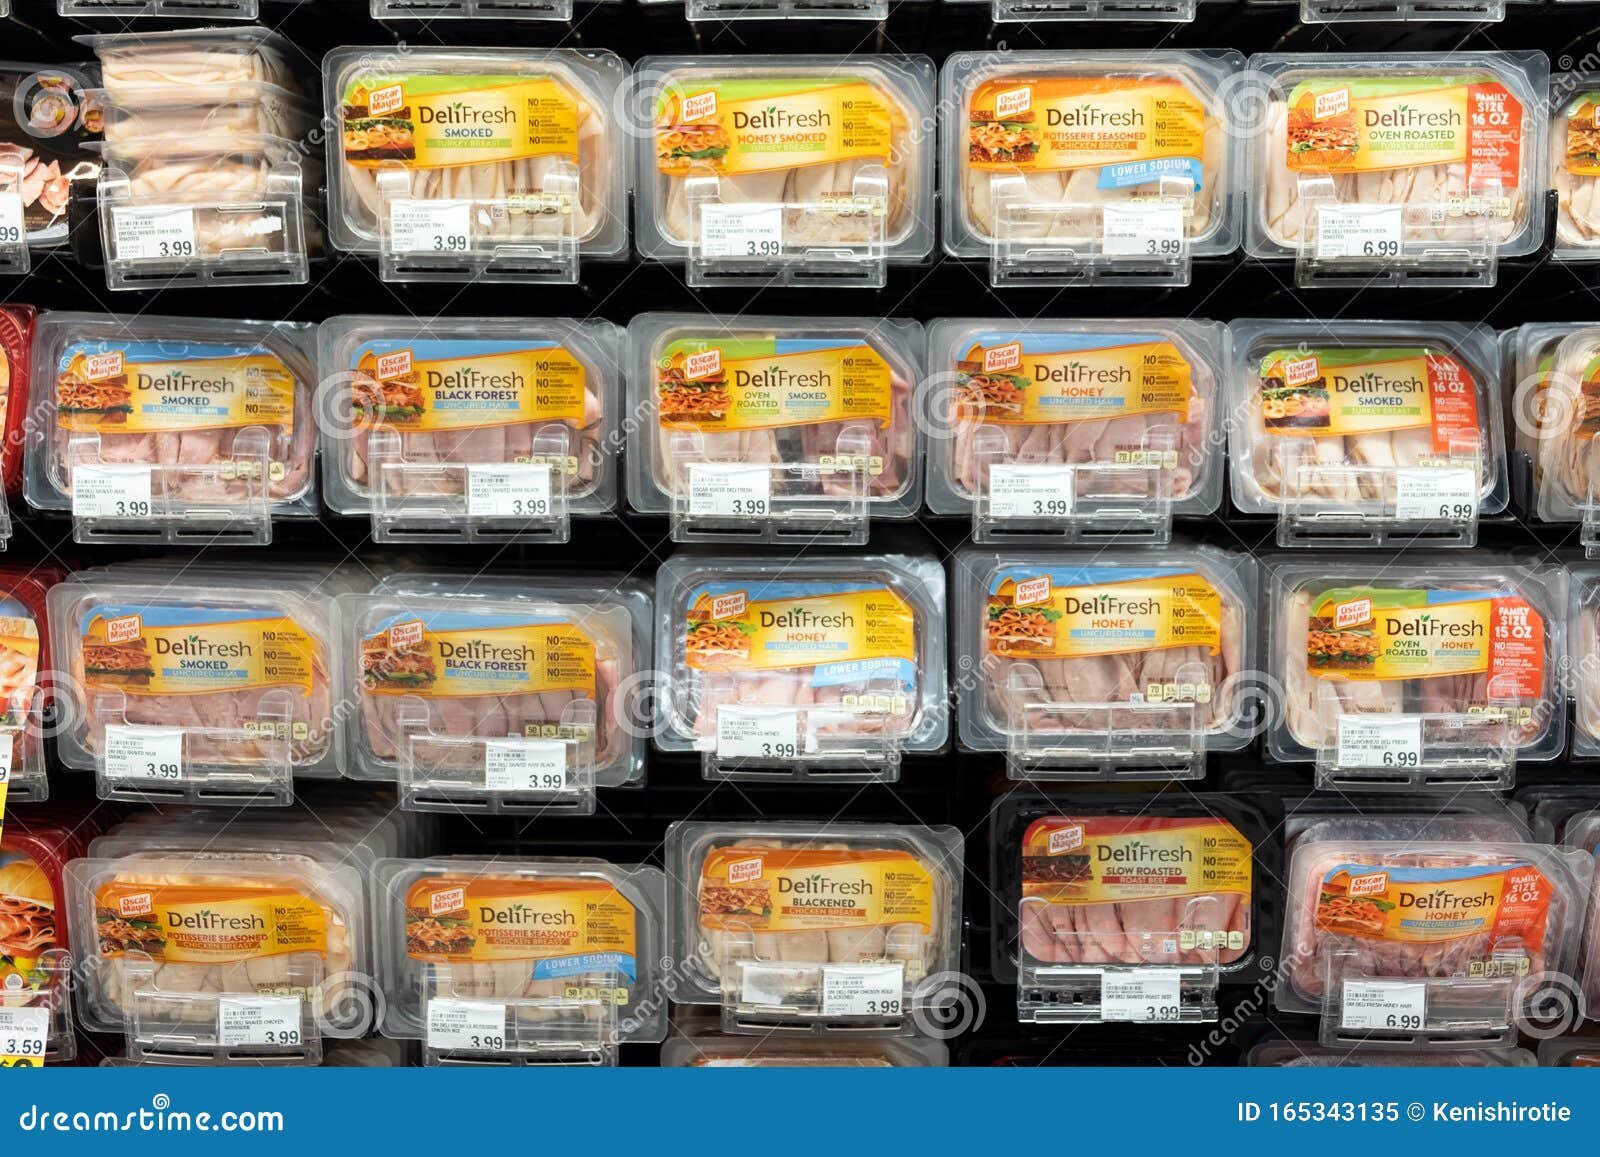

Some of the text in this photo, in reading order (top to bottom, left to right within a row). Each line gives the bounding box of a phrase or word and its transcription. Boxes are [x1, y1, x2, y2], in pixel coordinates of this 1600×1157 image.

[373, 90, 398, 102] Oscar
[687, 95, 712, 108] Oscar
[1001, 91, 1026, 104] Oscar
[1475, 93, 1507, 101] FAMILY
[372, 98, 401, 111] Mayer
[685, 102, 715, 117] Mayer
[999, 98, 1028, 113] Mayer
[1478, 103, 1503, 112] SIZE
[418, 105, 516, 124] DeliFresh
[733, 109, 830, 128] DeliFresh
[1046, 108, 1144, 126] DeliFresh
[1365, 109, 1460, 127] DeliFresh
[1472, 113, 1509, 125] 16 OZ
[445, 128, 493, 137] SMOKED
[738, 133, 826, 144] HONEY SMOKED
[1369, 130, 1454, 140] OVEN ROASTED
[1112, 160, 1191, 177] LOWER SODIUM
[160, 241, 192, 256] 3.99
[434, 235, 466, 250] 3.99
[747, 240, 779, 255] 3.99
[1146, 240, 1180, 253] 3.99
[1364, 241, 1398, 255] 6.99
[690, 354, 716, 365] Oscar
[989, 348, 1015, 360] Oscar
[91, 357, 118, 367] Oscar
[381, 355, 408, 366] Oscar
[988, 356, 1017, 367] Mayer
[90, 364, 120, 376] Mayer
[380, 362, 411, 376] Mayer
[689, 362, 718, 375] Mayer
[1034, 364, 1131, 383] DeliFresh
[138, 374, 234, 393] DeliFresh
[427, 370, 524, 388] DeliFresh
[735, 369, 830, 387] DeliFresh
[1333, 375, 1424, 393] DeliFresh
[1061, 388, 1104, 396] HONEY
[1433, 382, 1465, 392] 16 OZ
[162, 396, 210, 405] SMOKED
[435, 391, 518, 399] BLACK FOREST
[1358, 397, 1403, 406] SMOKED
[116, 501, 148, 515] 3.99
[513, 500, 546, 514] 3.99
[732, 500, 765, 514] 3.99
[1033, 500, 1066, 514] 3.99
[1440, 505, 1472, 519] 6.99
[1020, 581, 1045, 593] Oscar
[1019, 588, 1049, 601] Mayer
[716, 596, 742, 608] Oscar
[1065, 597, 1160, 614] DeliFresh
[715, 603, 744, 615] Mayer
[1340, 602, 1367, 616] Oscar
[1499, 607, 1529, 616] FAMILY
[760, 611, 853, 628] DeliFresh
[1339, 610, 1369, 625] Mayer
[1501, 616, 1527, 625] SIZE
[111, 620, 136, 630] Oscar
[1092, 620, 1133, 628] HONEY
[1386, 618, 1482, 636] DeliFresh
[110, 627, 138, 640] Mayer
[393, 626, 418, 636] Oscar
[787, 633, 826, 641] HONEY
[1495, 627, 1532, 638] 15 OZ
[392, 632, 420, 644] Mayer
[1394, 640, 1420, 648] OVEN
[155, 637, 251, 656] DeliFresh
[1441, 641, 1474, 649] HONEY
[439, 642, 535, 661] DeliFresh
[1386, 649, 1427, 657] ROASTED
[180, 660, 228, 669] SMOKED
[446, 660, 527, 670] BLACK FOREST
[824, 664, 857, 676] LOWER
[762, 743, 794, 756] 3.99
[1383, 752, 1417, 766] 6.99
[147, 763, 178, 778] 399
[529, 775, 561, 788] 3.99
[1053, 829, 1078, 841] Oscar
[1051, 836, 1080, 850] Mayer
[1203, 838, 1216, 847] NO
[1097, 844, 1192, 861] DeliFresh
[733, 862, 758, 872] Oscar
[1203, 856, 1215, 866] NO
[731, 868, 760, 880] Mayer
[1106, 867, 1182, 875] SLOW ROASTED
[1203, 870, 1216, 879] NO
[1355, 875, 1383, 885] Oscar
[1511, 875, 1539, 883] FAMILY
[778, 877, 872, 895] DeliFresh
[1352, 883, 1384, 893] Mayer
[1512, 883, 1536, 892] SIZE
[123, 896, 149, 905] Oscar
[435, 891, 460, 901] Oscar
[1399, 892, 1494, 908] DeliFresh
[1521, 891, 1538, 902] OZ
[122, 903, 149, 913] Mayer
[435, 898, 462, 908] Mayer
[793, 899, 855, 907] BLACKENED
[167, 911, 264, 929] DeliFresh
[480, 907, 575, 925] DeliFresh
[167, 932, 267, 941] ROTISSERIE SEASONED
[478, 929, 528, 937] ROTISSERIE
[545, 954, 622, 969] LOWER SODIUM
[866, 1001, 899, 1013] 3.99
[1146, 1007, 1178, 1020] 3.99
[1387, 1015, 1420, 1028] 6.99
[265, 1031, 299, 1044] 399
[471, 1036, 503, 1049] 399
[6, 1038, 43, 1055] 3.59
